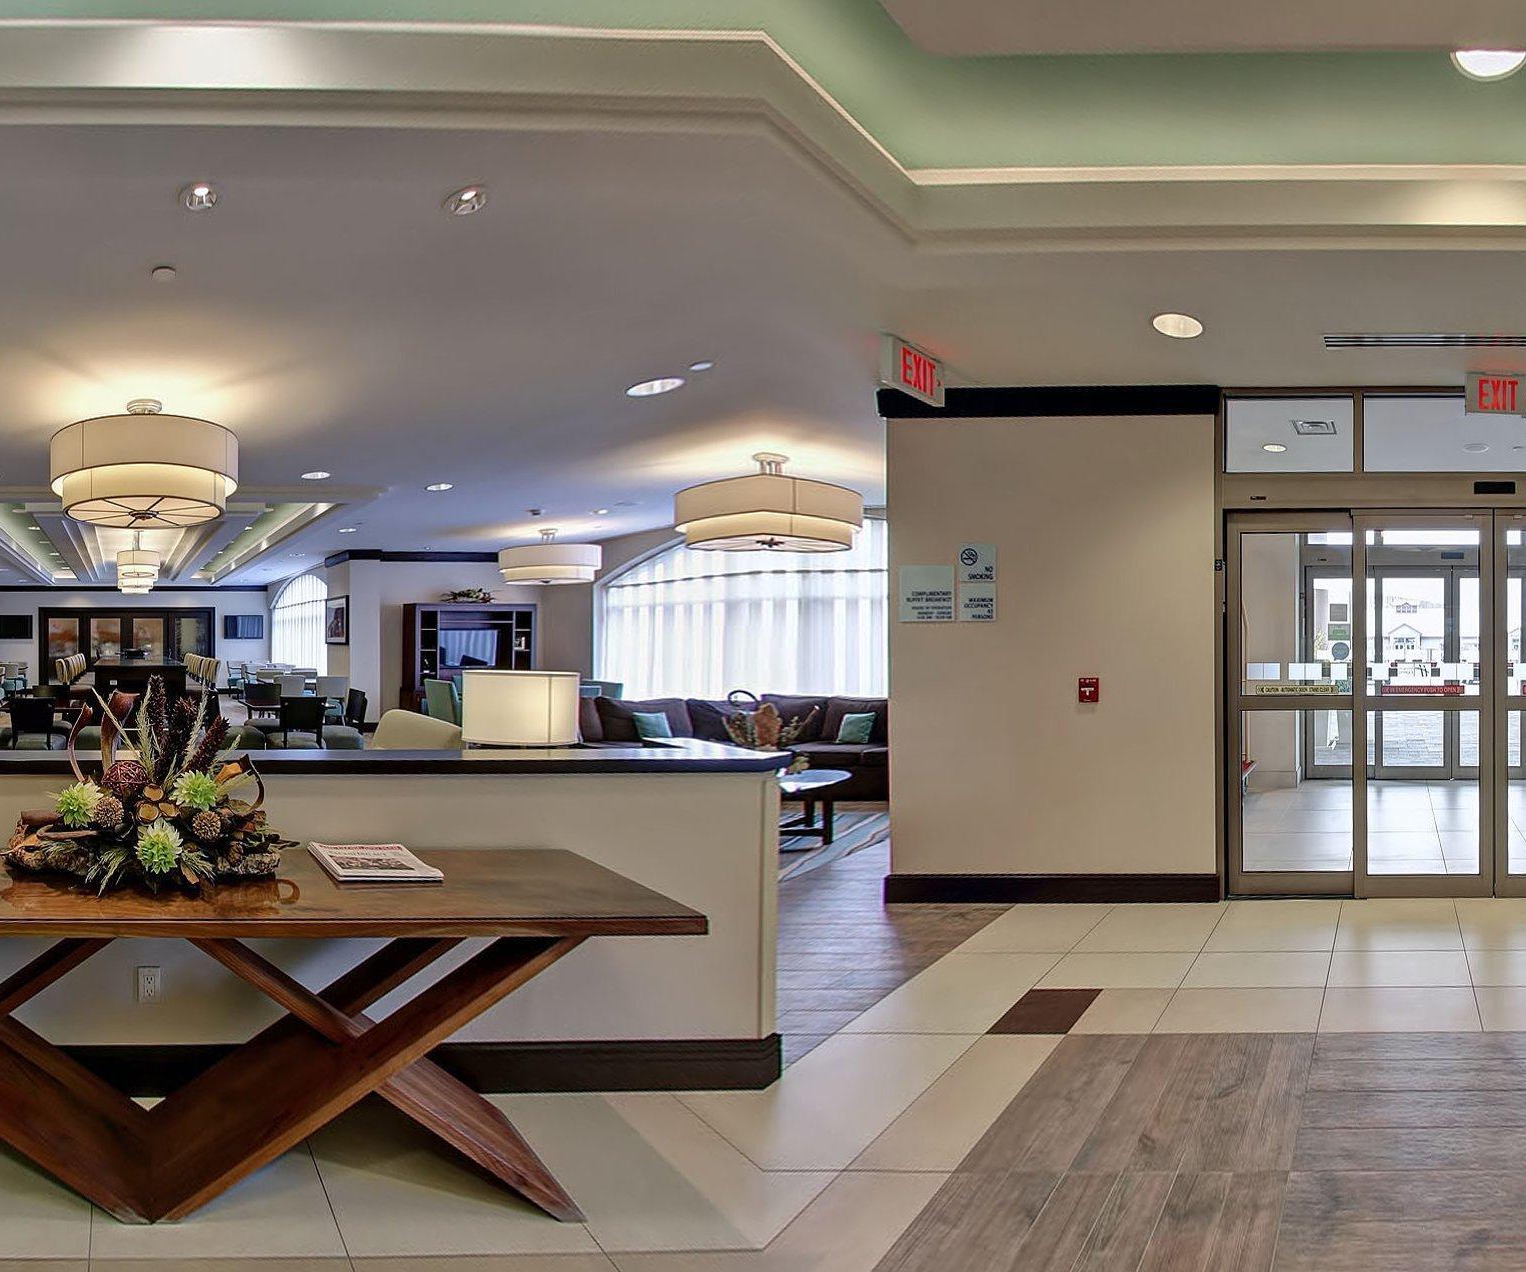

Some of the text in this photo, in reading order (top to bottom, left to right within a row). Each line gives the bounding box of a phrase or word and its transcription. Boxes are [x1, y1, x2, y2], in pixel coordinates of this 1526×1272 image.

[901, 346, 936, 397] EXIT
[1478, 379, 1518, 411] EXIT
[1444, 686, 1457, 694] OPEN
